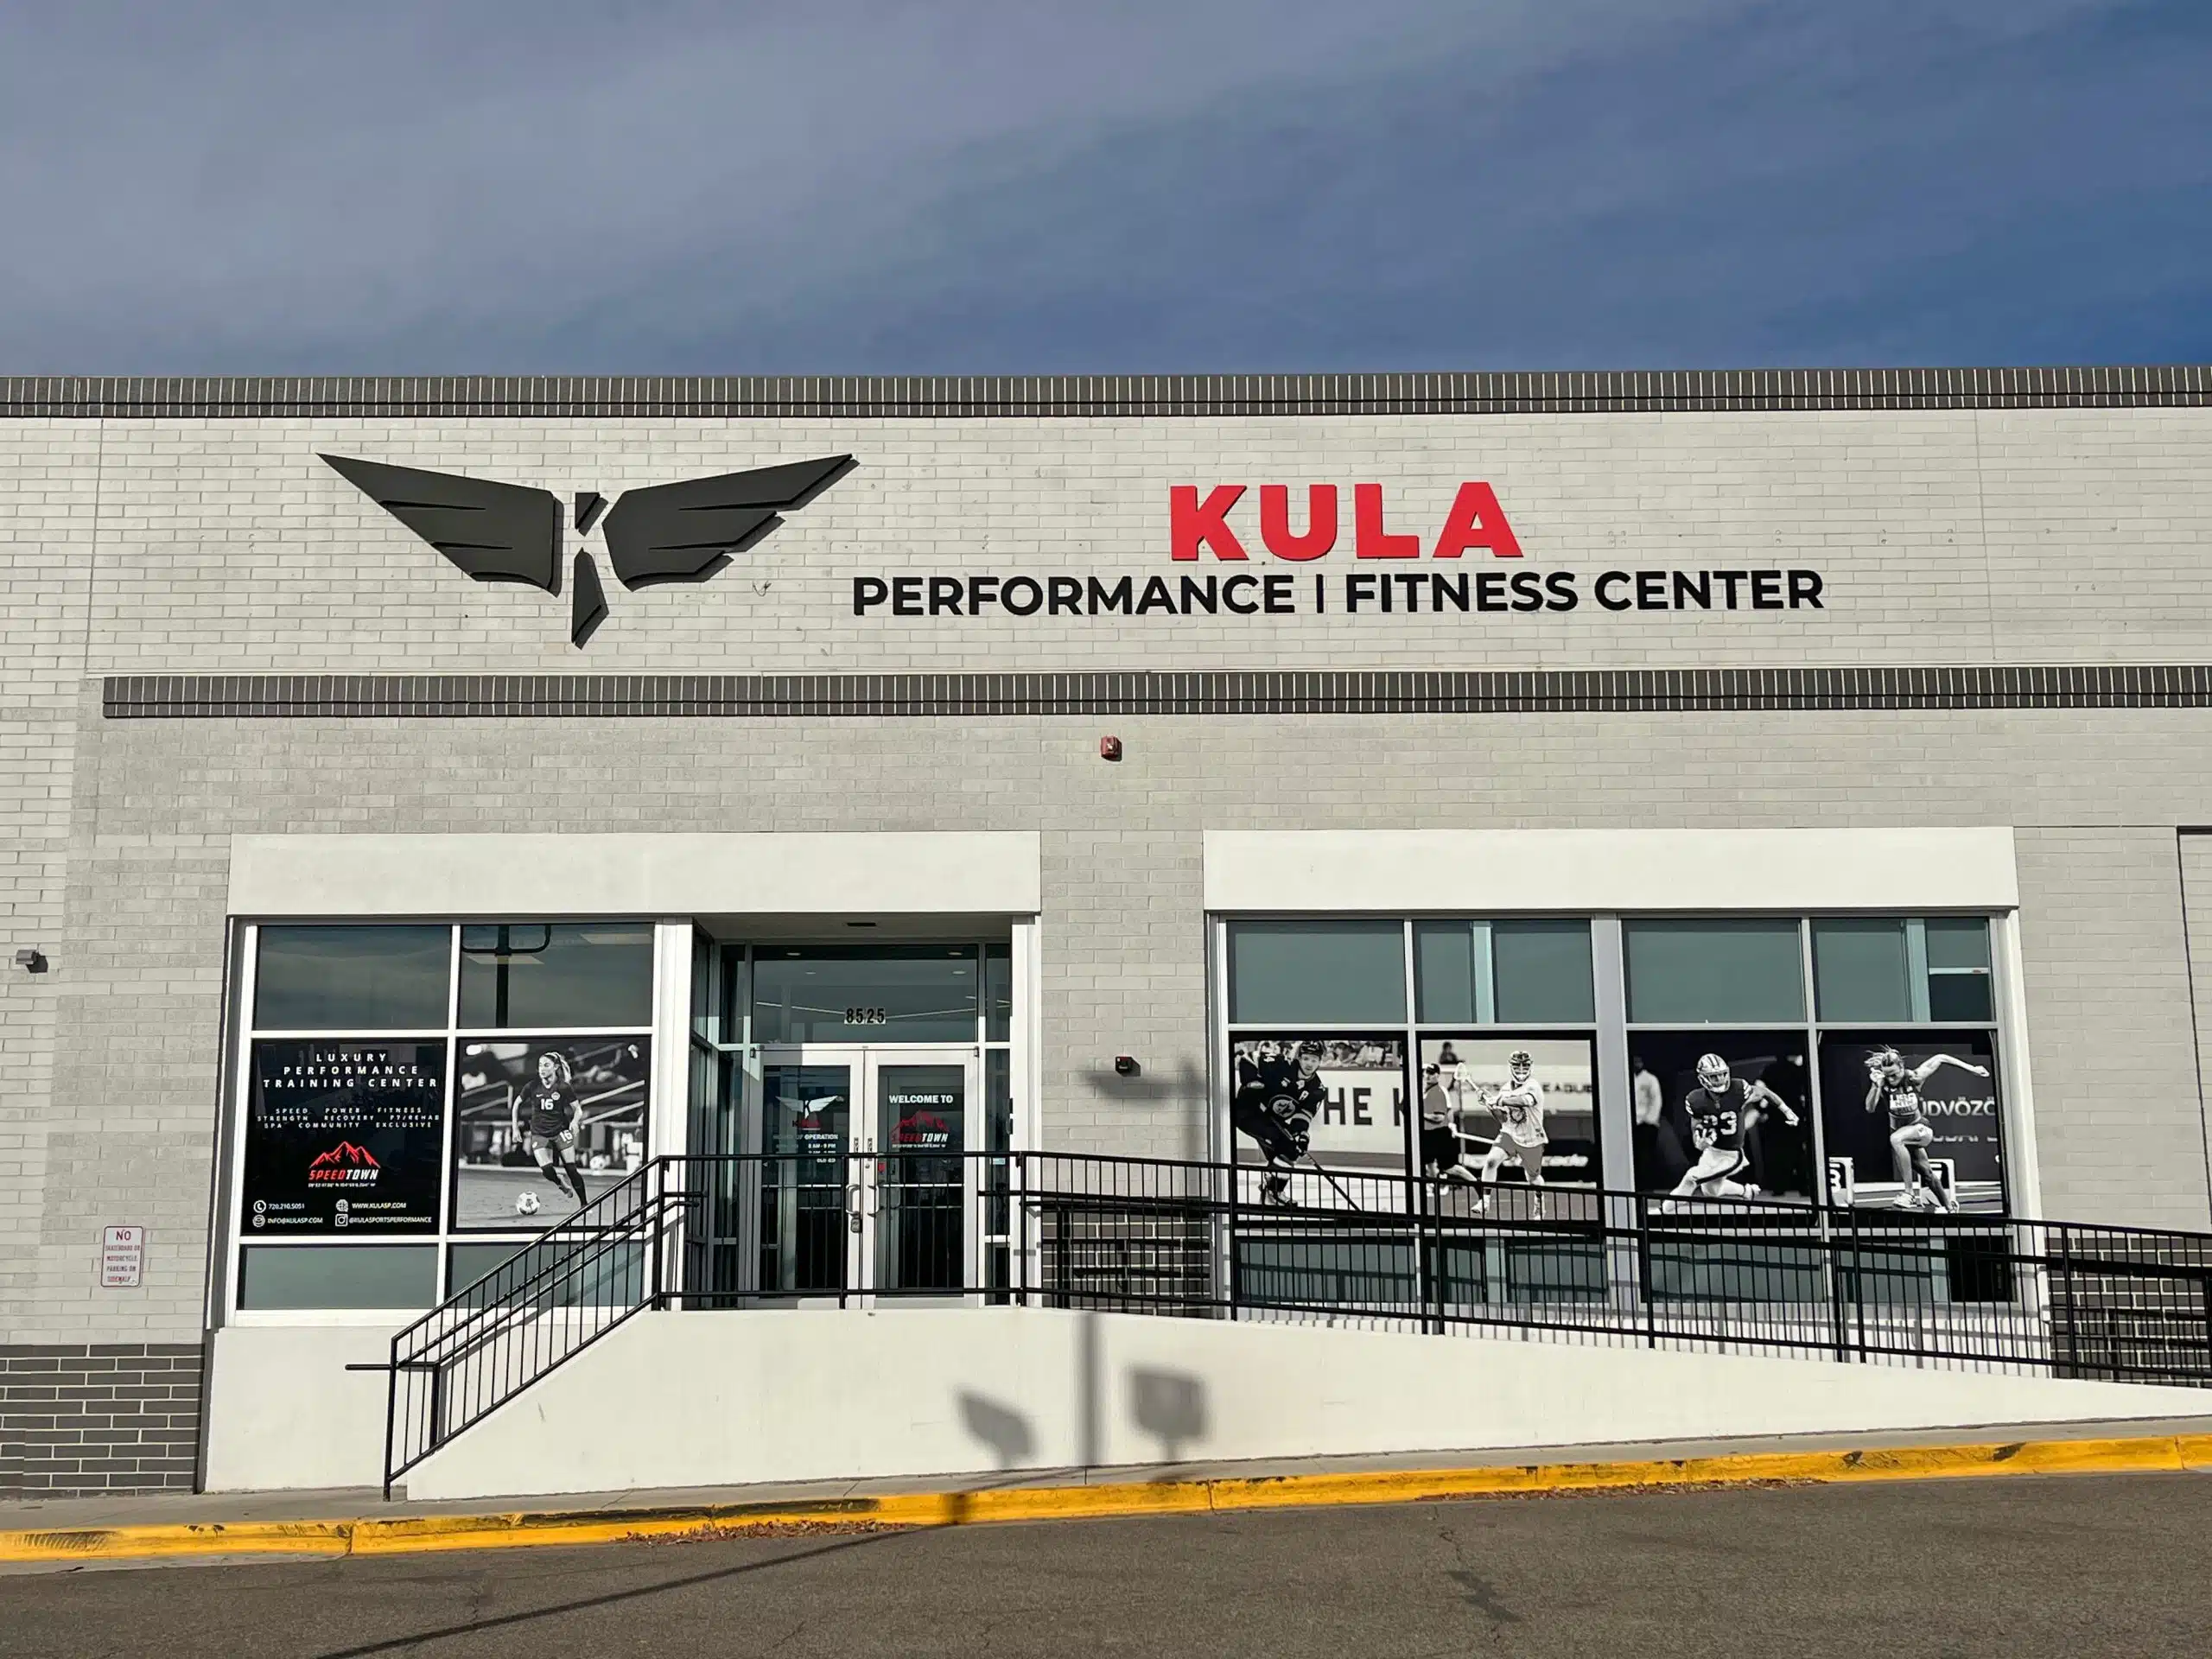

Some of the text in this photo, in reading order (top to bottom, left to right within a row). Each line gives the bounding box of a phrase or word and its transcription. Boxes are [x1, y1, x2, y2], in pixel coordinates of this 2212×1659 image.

[1170, 482, 1524, 562] KULA
[854, 575, 1295, 616] PERFORMANCE
[1346, 572, 1579, 613] FITNESS
[1594, 569, 1825, 611] CENTER
[846, 1007, 885, 1024] 8525
[316, 1053, 386, 1062] LUXURY
[283, 1065, 419, 1075] PERFORMANCE
[264, 1078, 436, 1088] TRAINING CENTER
[540, 1098, 554, 1110] 16
[888, 1095, 954, 1103] WELCOME TO
[559, 1129, 573, 1141] 16
[308, 1168, 379, 1180] SPEEDTOWN
[116, 1230, 131, 1241] NO
